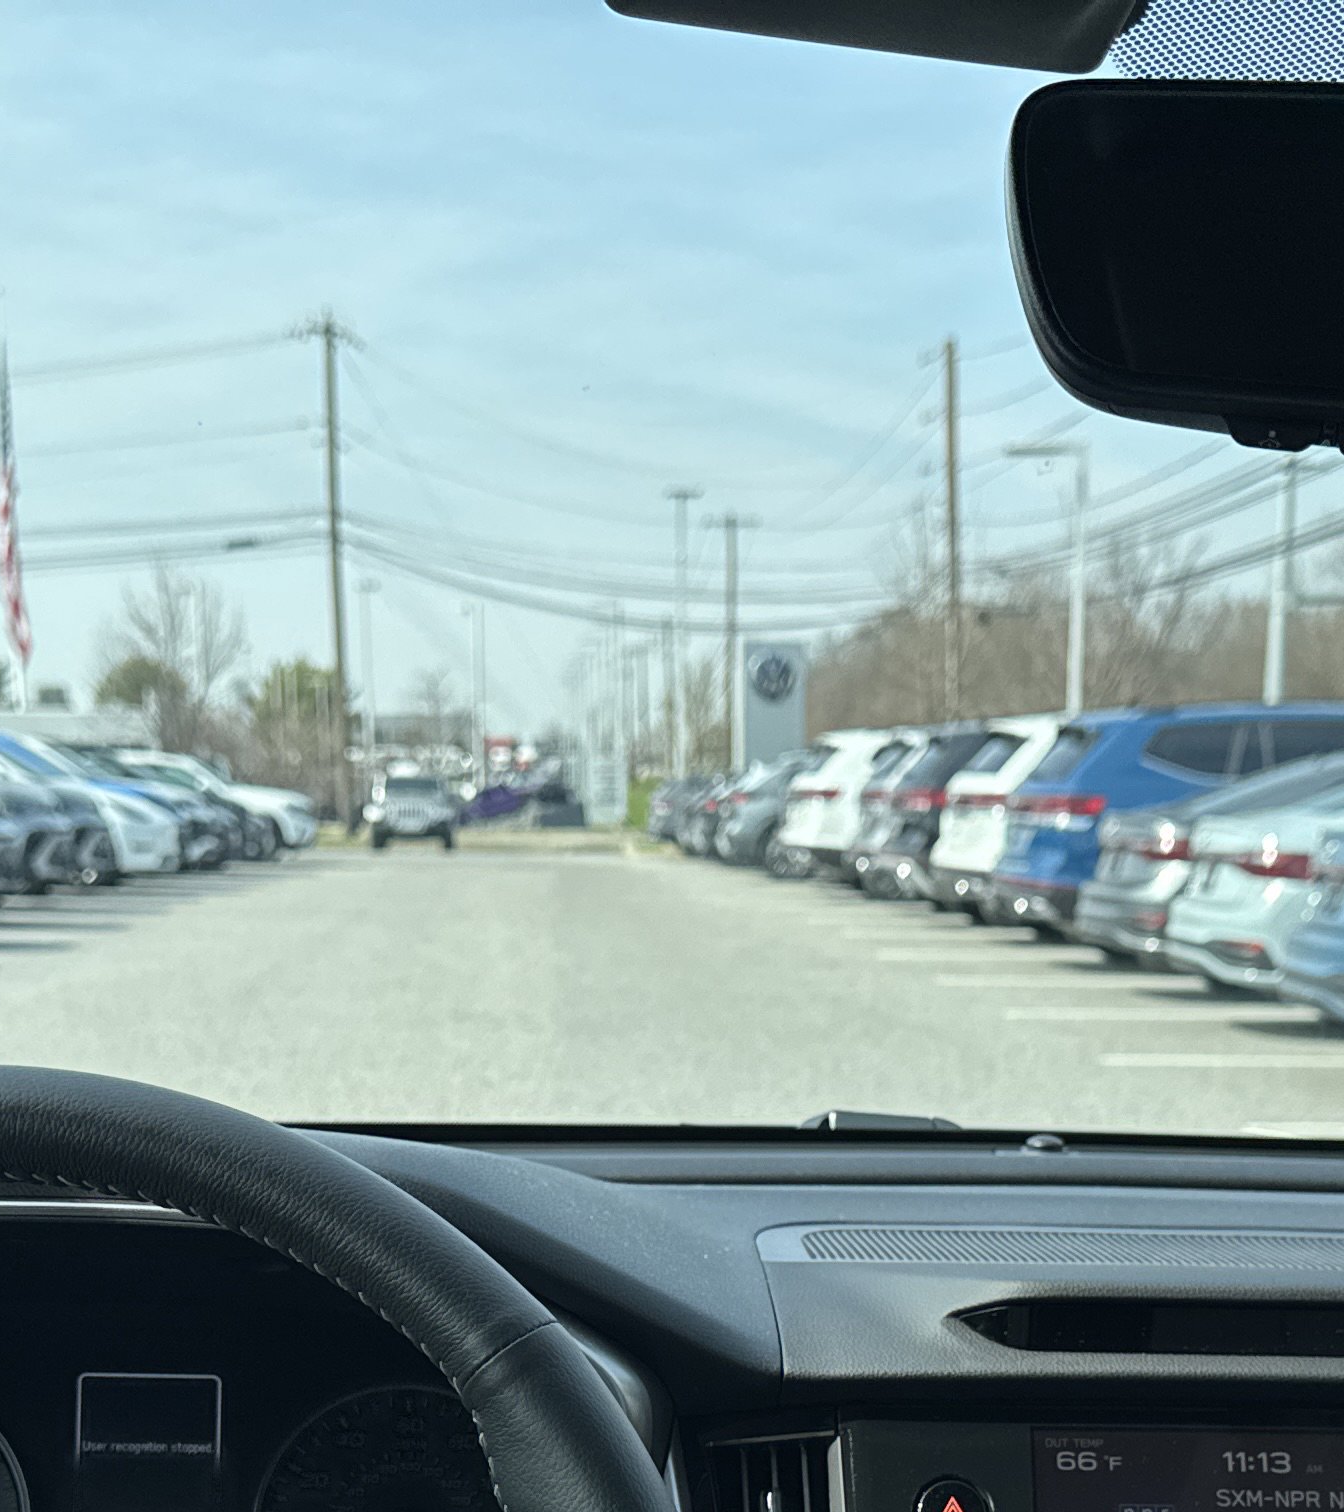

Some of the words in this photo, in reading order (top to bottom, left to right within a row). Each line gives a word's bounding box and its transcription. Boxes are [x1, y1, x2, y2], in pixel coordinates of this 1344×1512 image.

[82, 1441, 108, 1453] User
[111, 1441, 168, 1455] recognition
[1045, 1438, 1069, 1448] OUT
[1073, 1438, 1104, 1449] TEMP
[1056, 1450, 1098, 1471] 66
[1221, 1451, 1293, 1473] 11:13
[1215, 1489, 1321, 1509] SXM-NPR
